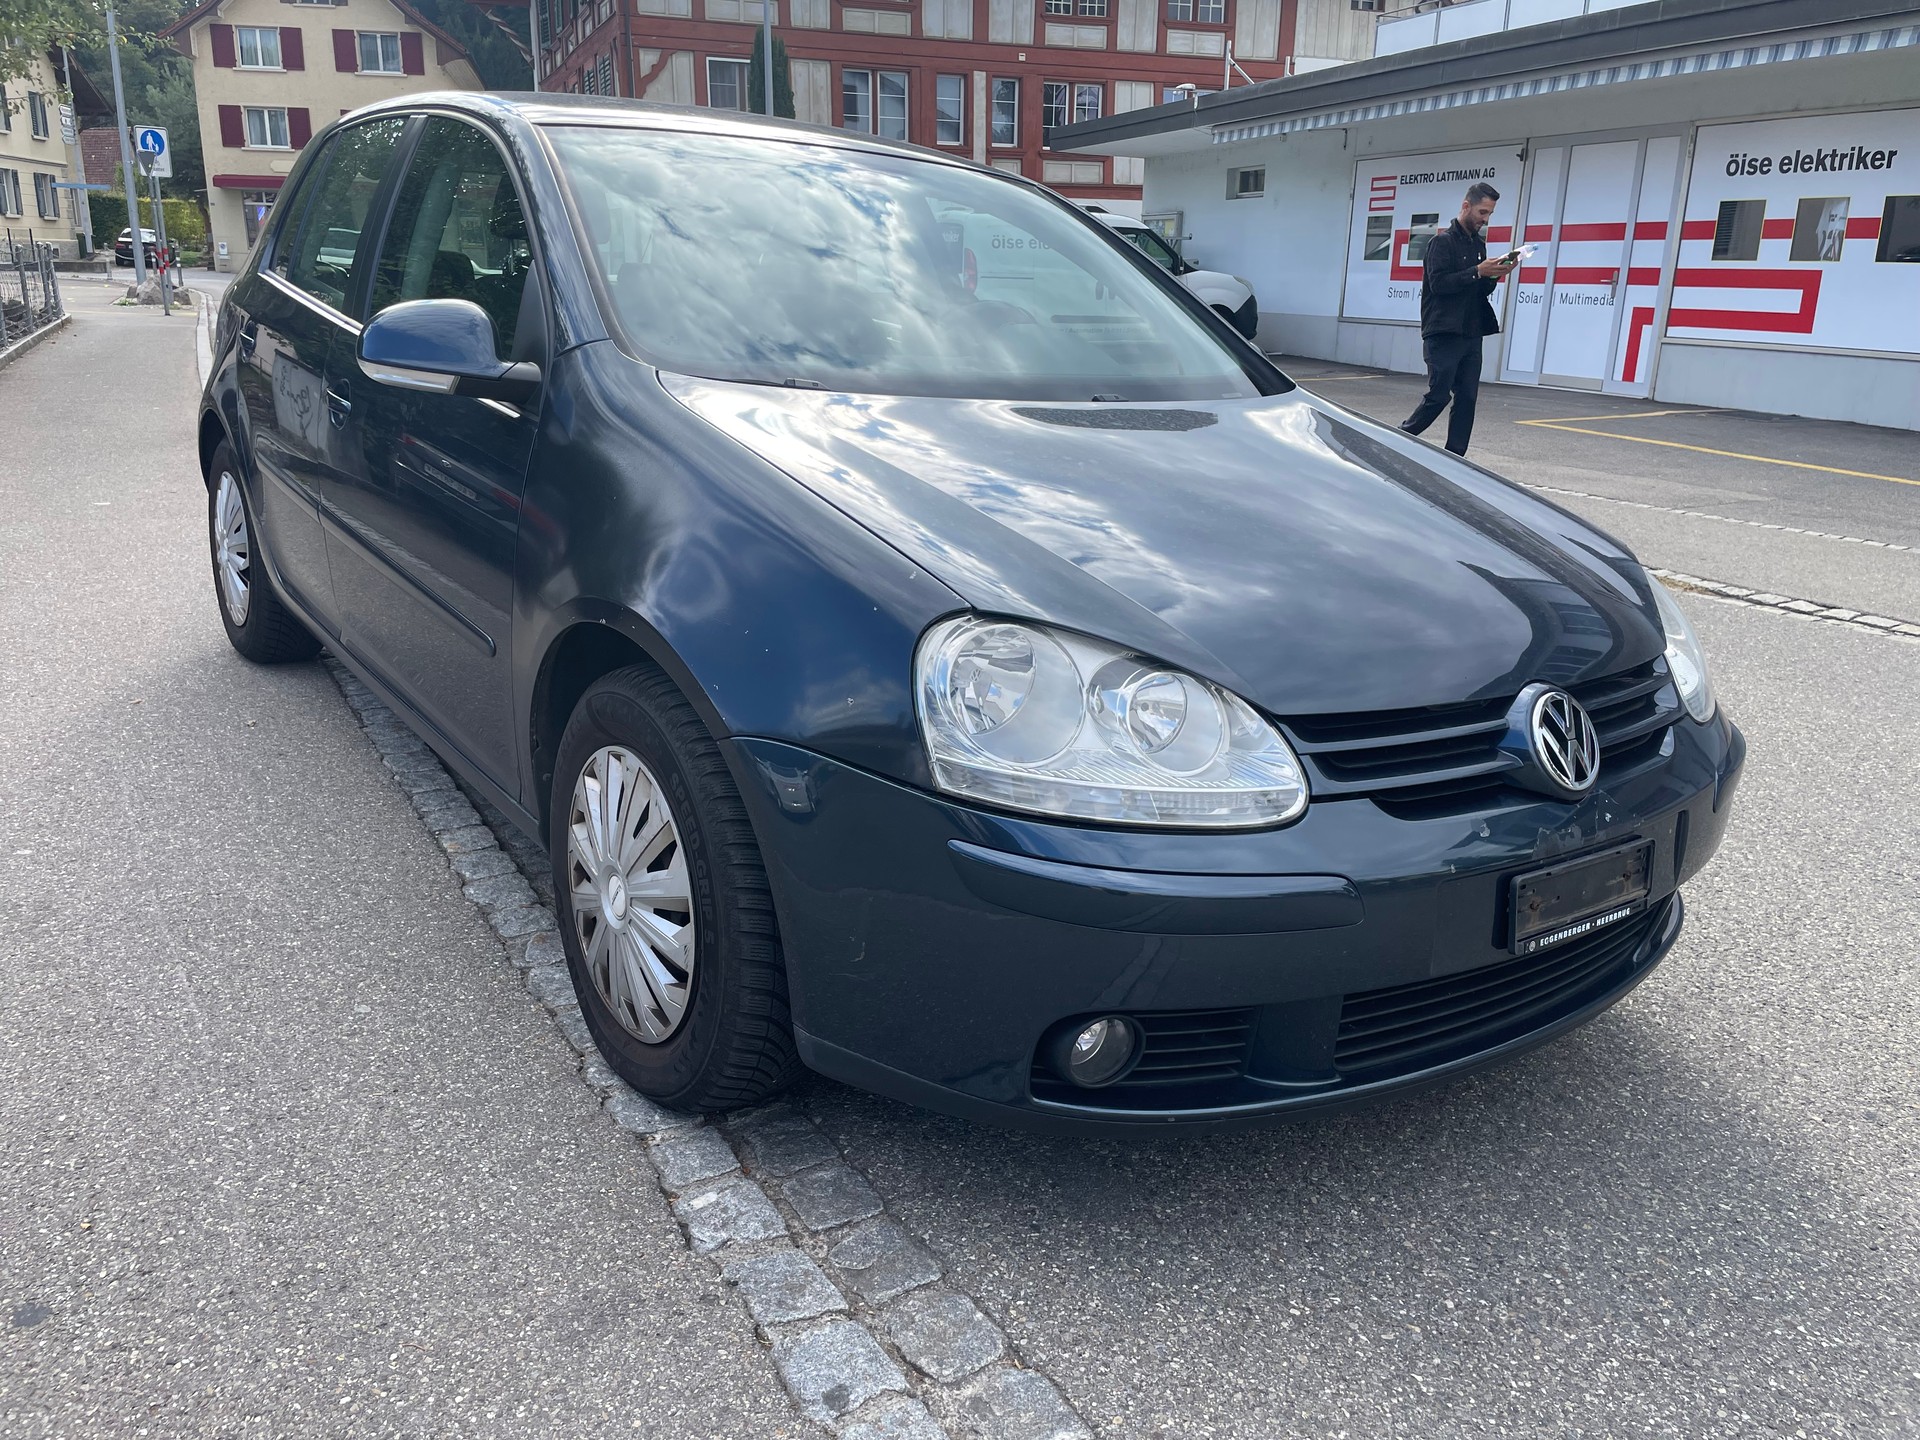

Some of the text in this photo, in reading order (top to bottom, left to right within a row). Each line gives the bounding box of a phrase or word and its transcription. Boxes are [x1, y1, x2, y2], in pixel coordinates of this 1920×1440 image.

[1725, 146, 1898, 177] öise elektriker
[1400, 167, 1496, 185] ELEKTRO LATTMANN AG
[991, 234, 1024, 249] öise
[1387, 286, 1410, 299] Strom
[1518, 291, 1543, 305] Solar
[1559, 292, 1615, 306] Multimedia
[671, 772, 713, 921] SPEED-GRIP
[1540, 922, 1591, 947] EGGENBERGER
